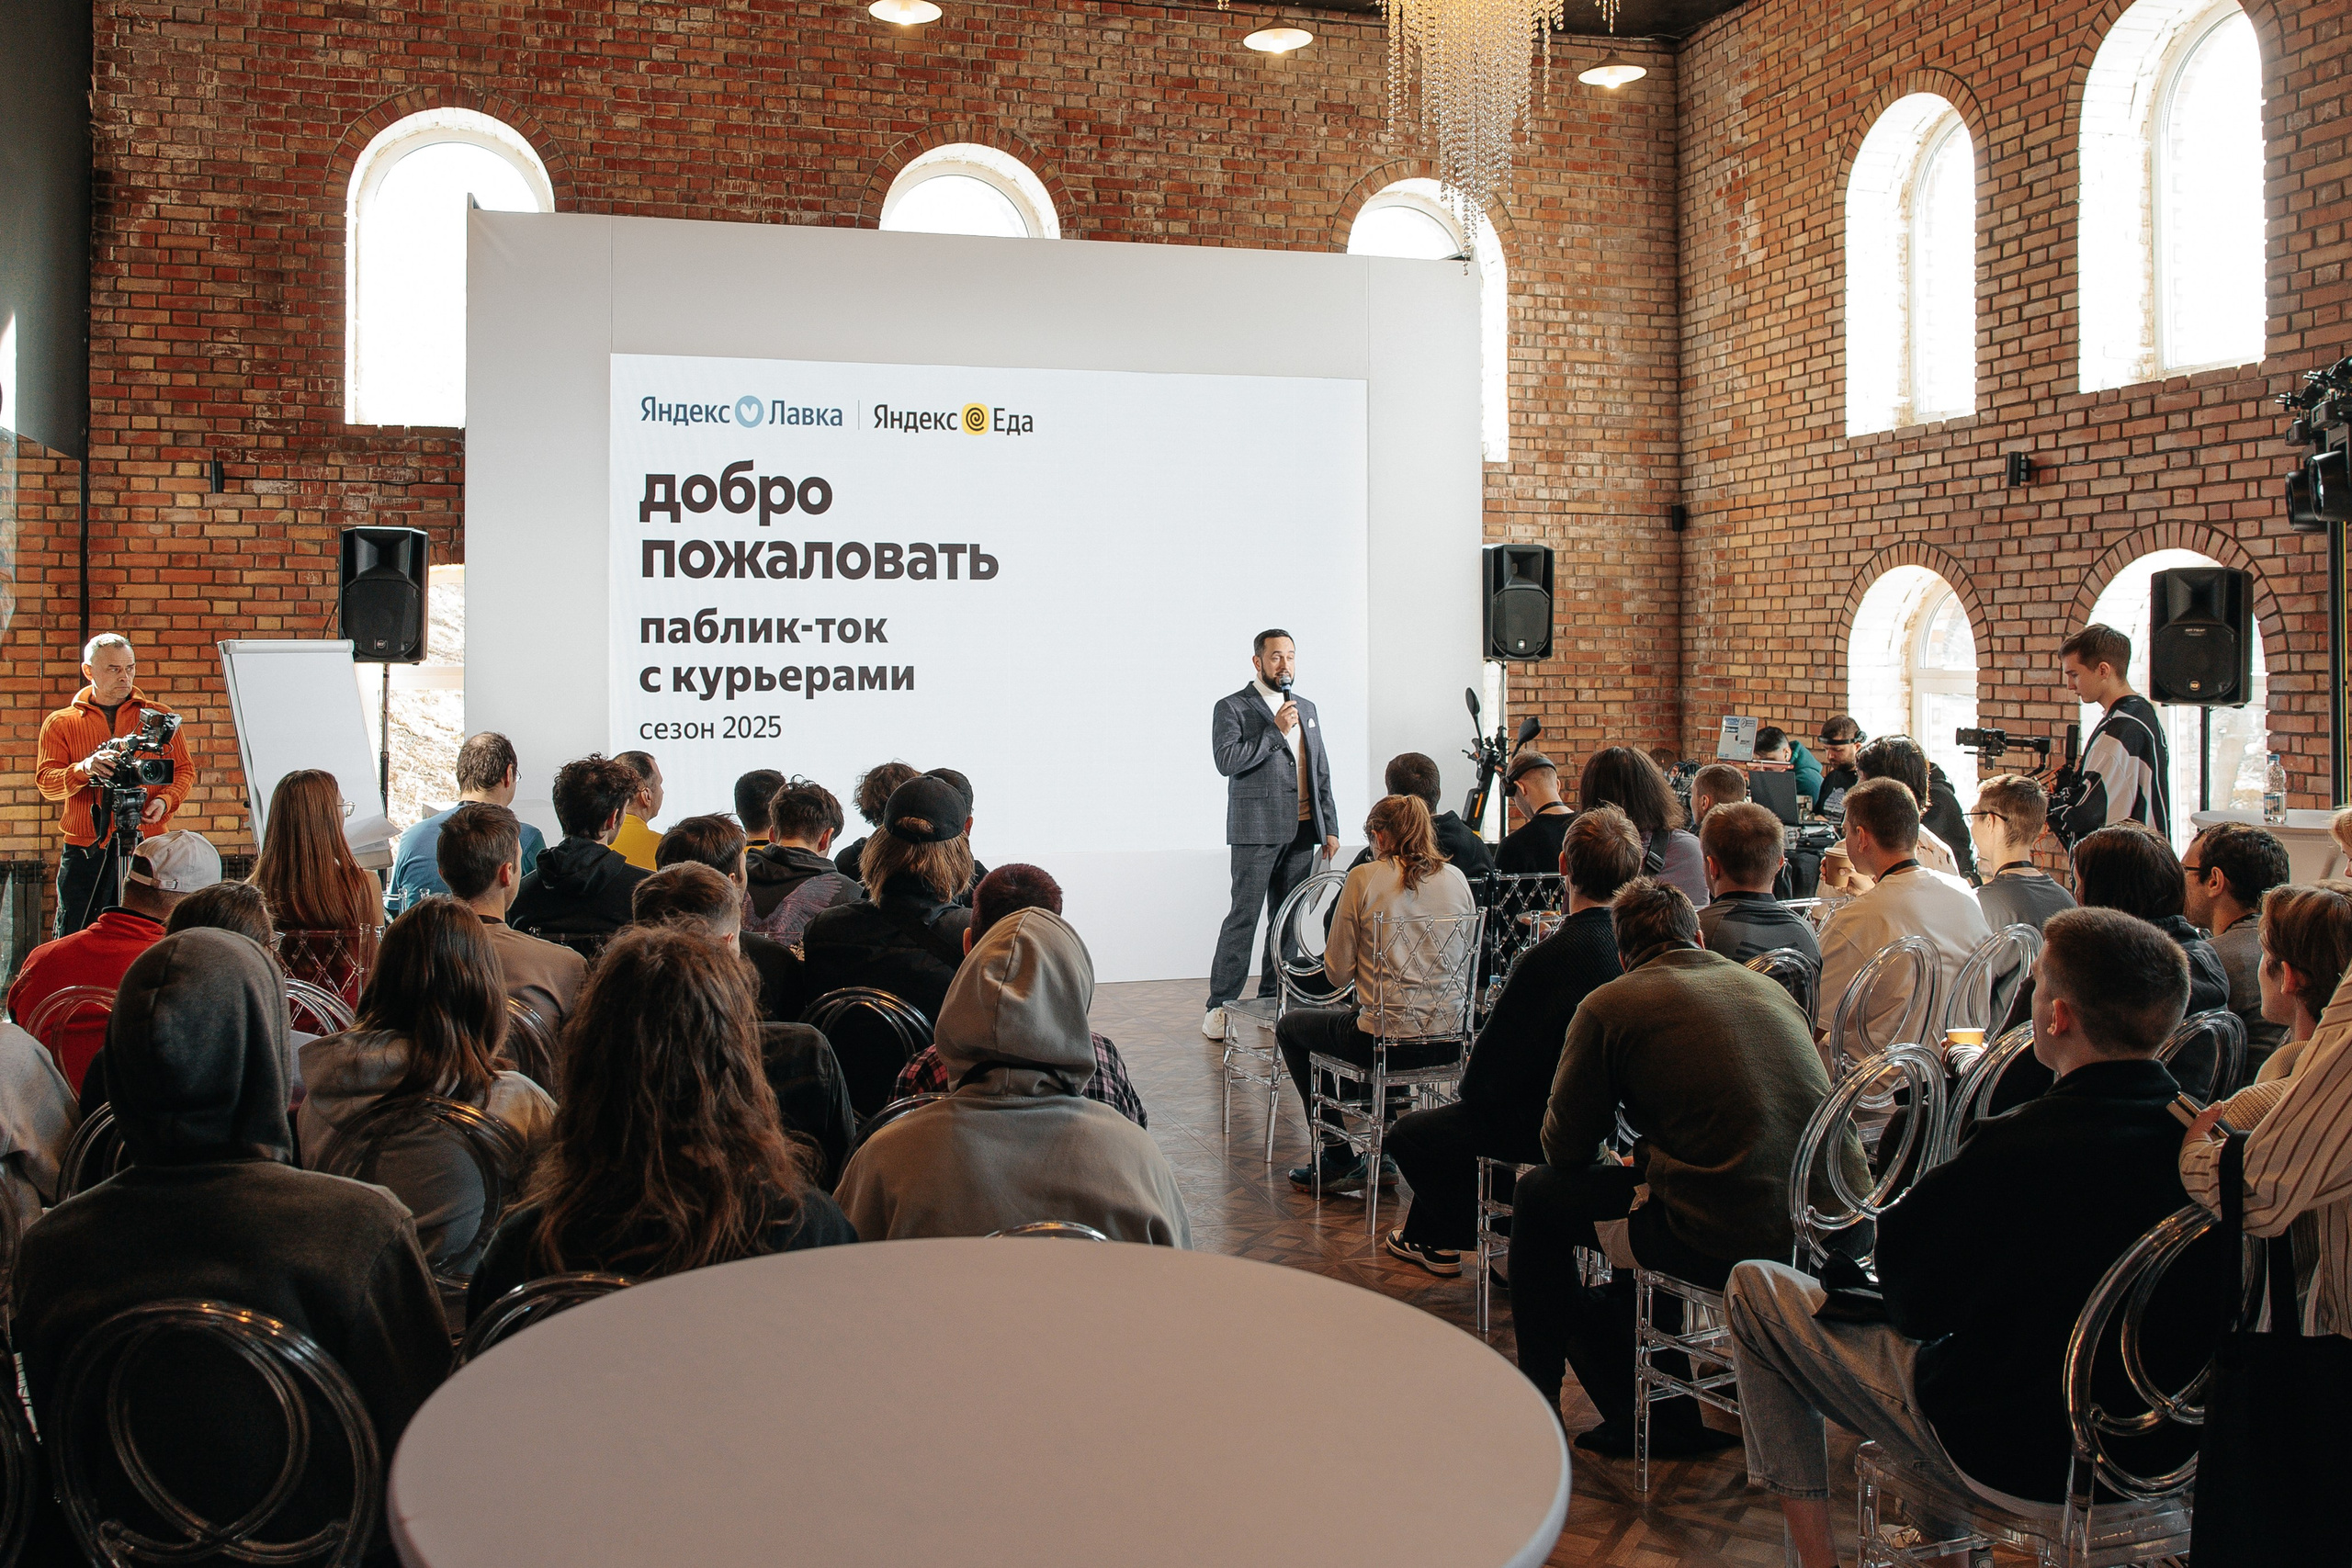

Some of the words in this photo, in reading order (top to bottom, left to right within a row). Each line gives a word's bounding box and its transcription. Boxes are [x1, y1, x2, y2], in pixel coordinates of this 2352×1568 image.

[640, 396, 730, 427] Яндекс
[768, 400, 843, 427] Лавка
[874, 403, 958, 434] Яндекс
[993, 407, 1034, 436] Еда
[639, 458, 833, 527] добро
[641, 538, 1000, 581] пожаловать
[640, 606, 888, 644] паблик-ток
[639, 666, 662, 694] с
[673, 665, 915, 702] курьерами
[639, 722, 715, 740] сезон
[722, 715, 782, 739] 2025
